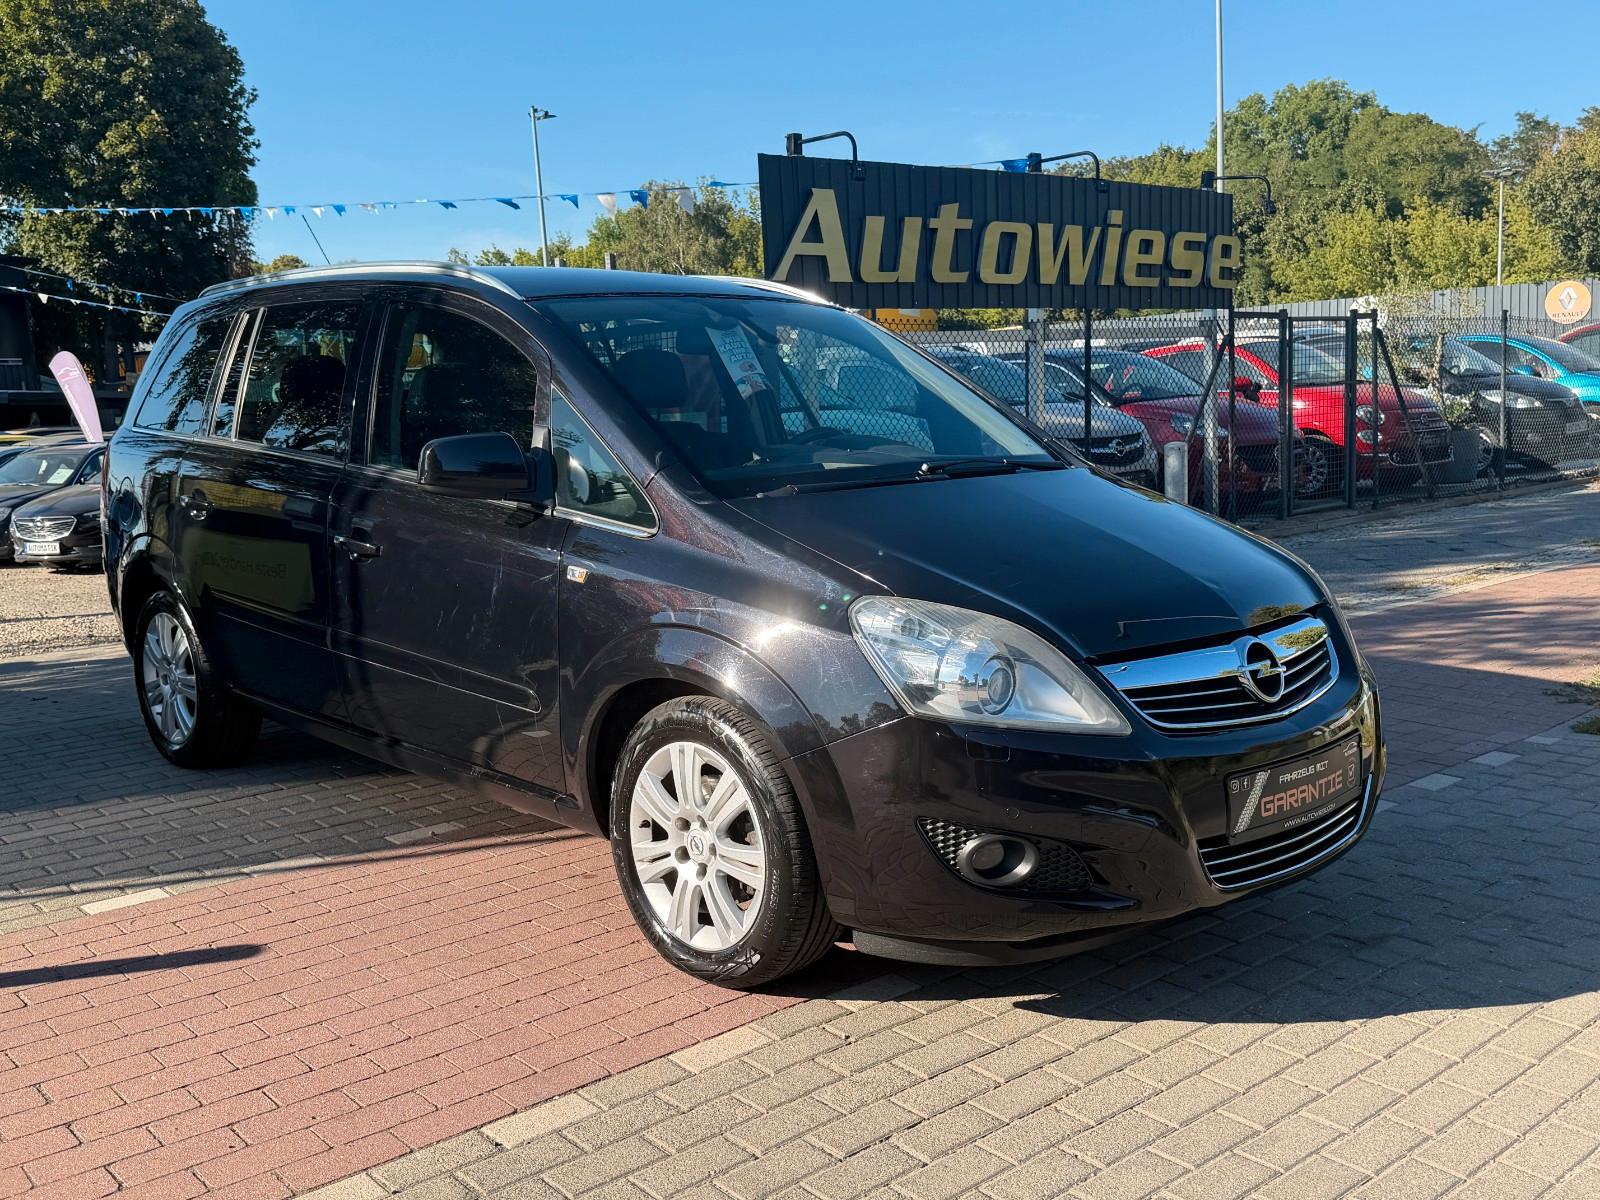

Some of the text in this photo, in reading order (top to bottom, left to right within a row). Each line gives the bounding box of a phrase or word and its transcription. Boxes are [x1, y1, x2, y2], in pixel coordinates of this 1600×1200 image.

[773, 187, 1242, 289] Autowiese
[1260, 770, 1343, 817] GARANTIE
[1279, 766, 1315, 784] FAHRZEUG
